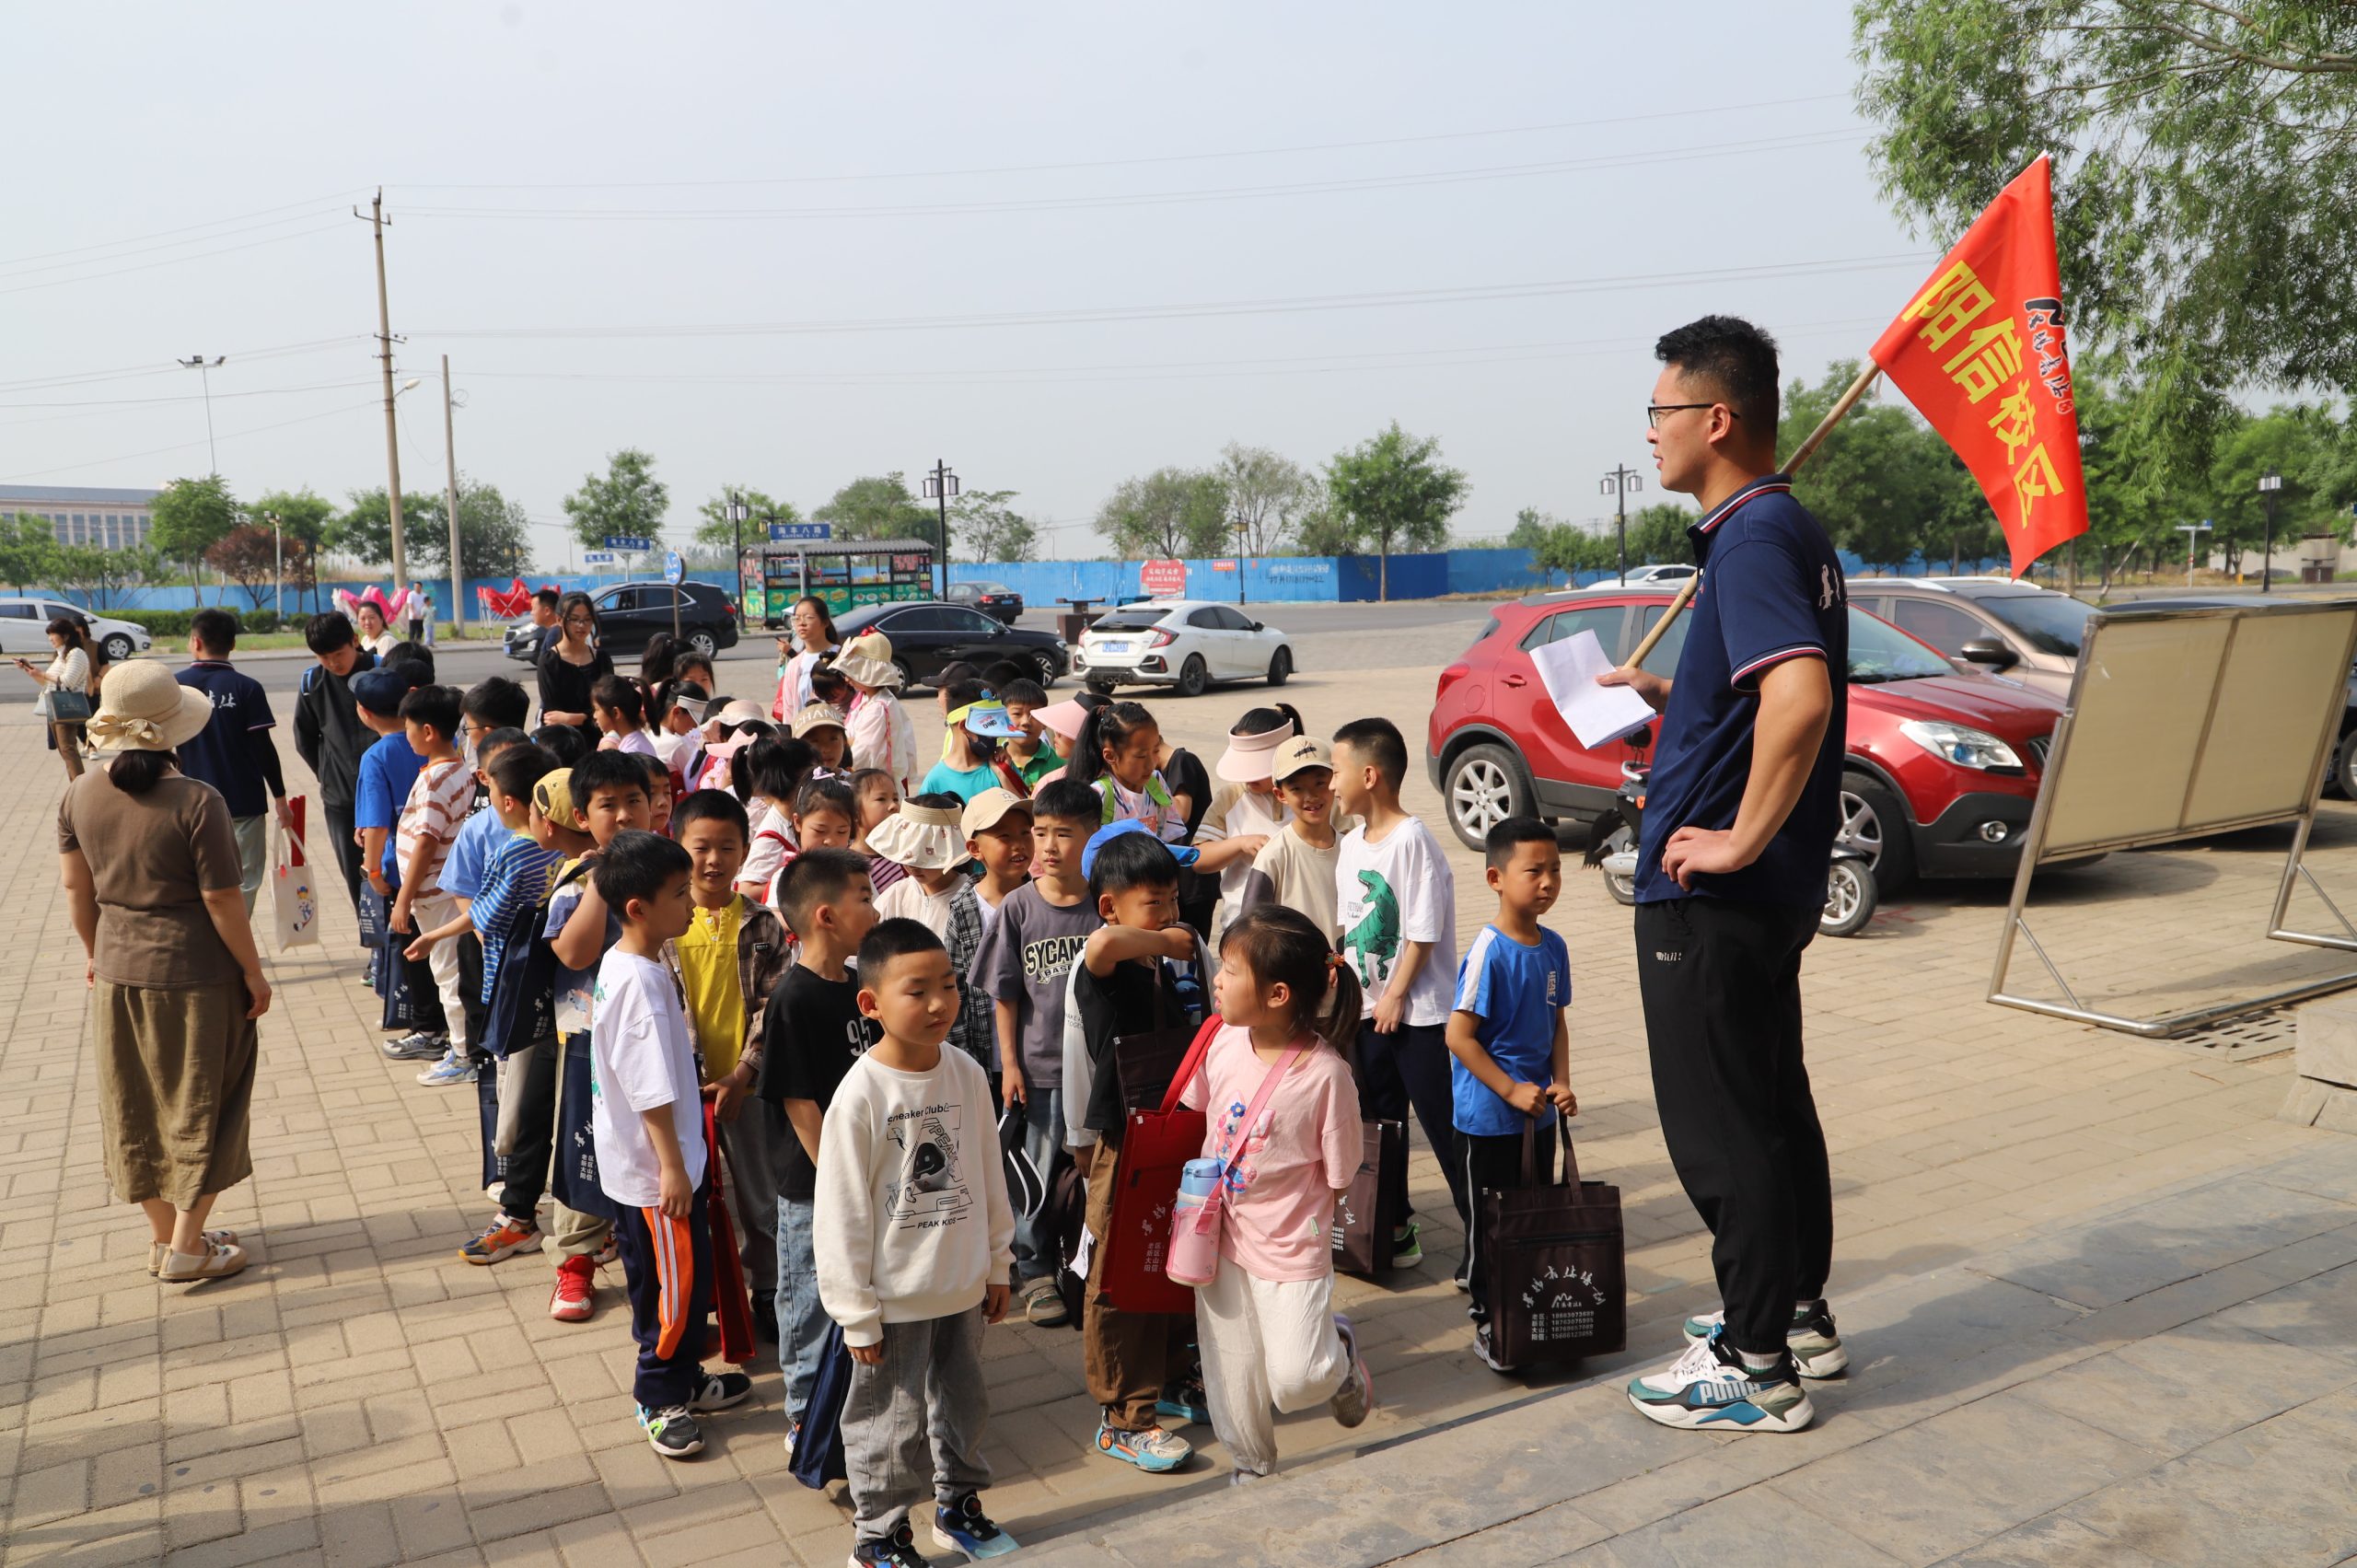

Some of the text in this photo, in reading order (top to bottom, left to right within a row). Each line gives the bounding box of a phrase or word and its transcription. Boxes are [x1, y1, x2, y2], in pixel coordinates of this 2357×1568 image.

[1901, 260, 2064, 530] 阳信校区
[917, 1216, 957, 1230] PEAK KIDS
[1699, 1379, 1761, 1404] PUMA
